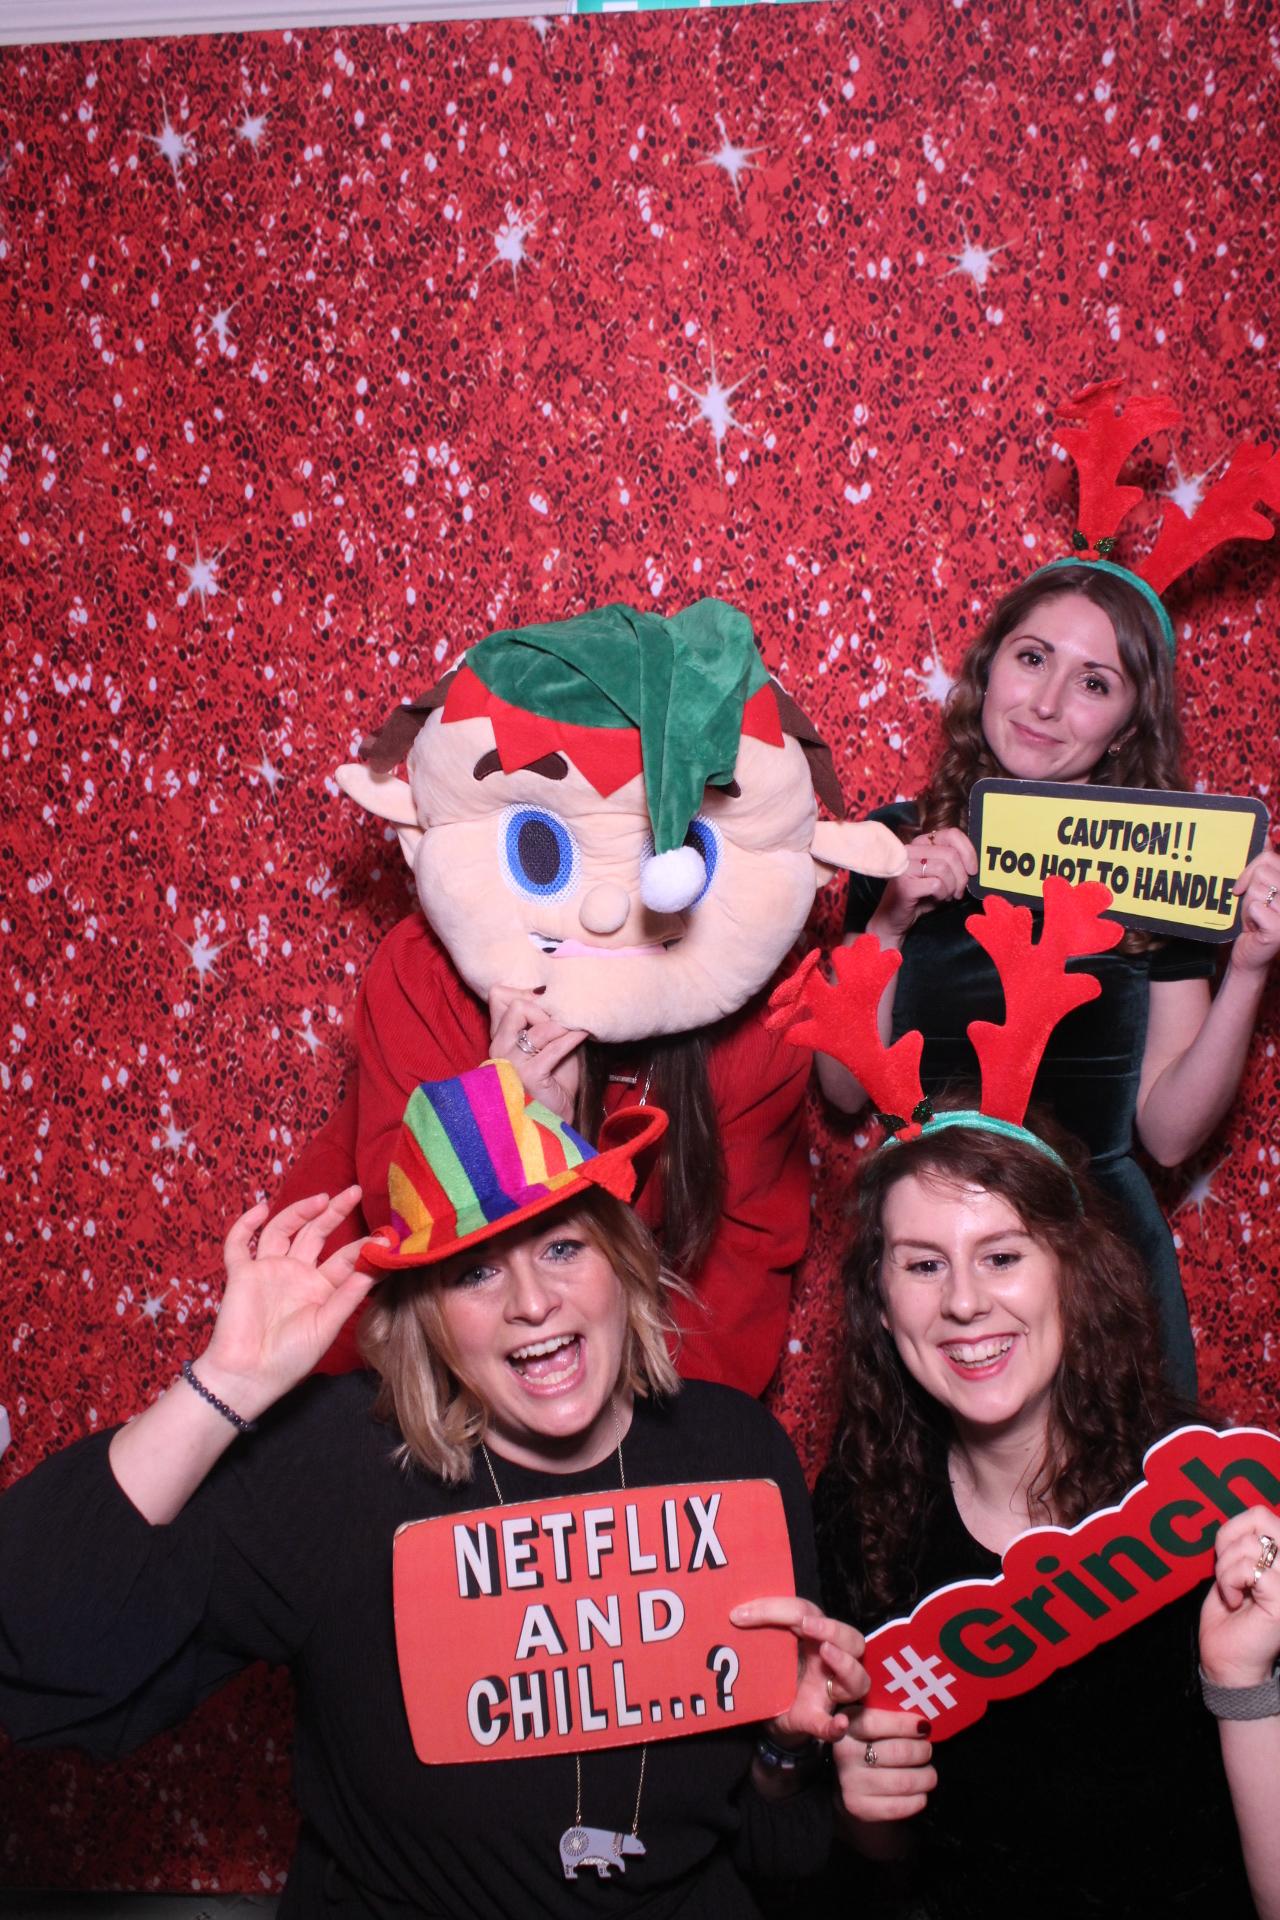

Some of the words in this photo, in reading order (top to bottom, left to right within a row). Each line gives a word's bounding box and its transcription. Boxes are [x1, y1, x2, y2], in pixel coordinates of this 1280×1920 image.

[986, 846, 1035, 877] TOO
[1039, 854, 1093, 885] HOT
[1097, 861, 1129, 894] TO
[1133, 867, 1238, 916] HANDLE
[1057, 816, 1197, 863] CAUTION!!
[453, 1493, 729, 1599] NETFLIX
[881, 1456, 1280, 1720] #Grinch
[514, 1589, 686, 1660] AND
[466, 1645, 739, 1746] CHILL...?
